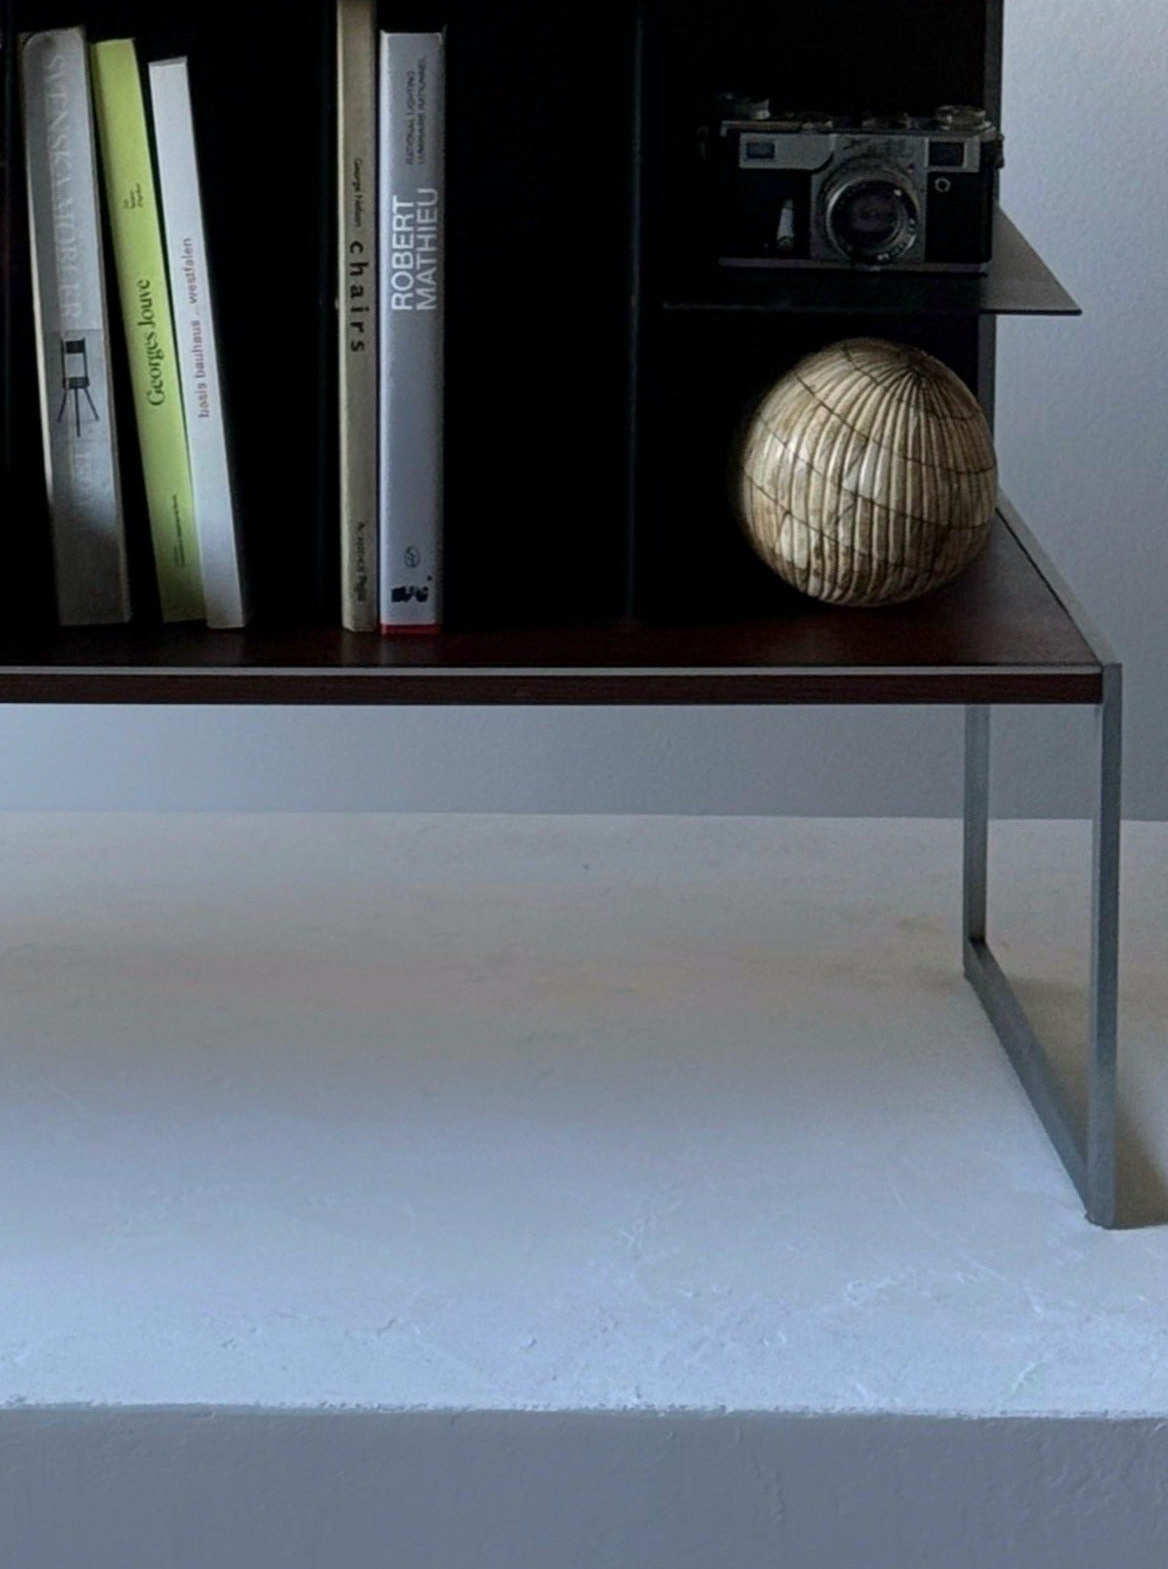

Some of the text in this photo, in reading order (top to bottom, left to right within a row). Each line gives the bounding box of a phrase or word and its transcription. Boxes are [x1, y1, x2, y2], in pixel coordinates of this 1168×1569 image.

[349, 241, 370, 353] chairs
[390, 194, 415, 311] ROBERT
[416, 187, 439, 311] MATHIEU
[136, 278, 165, 407] Georges Jouve
[180, 237, 210, 419] basis bauhaus westfalen
